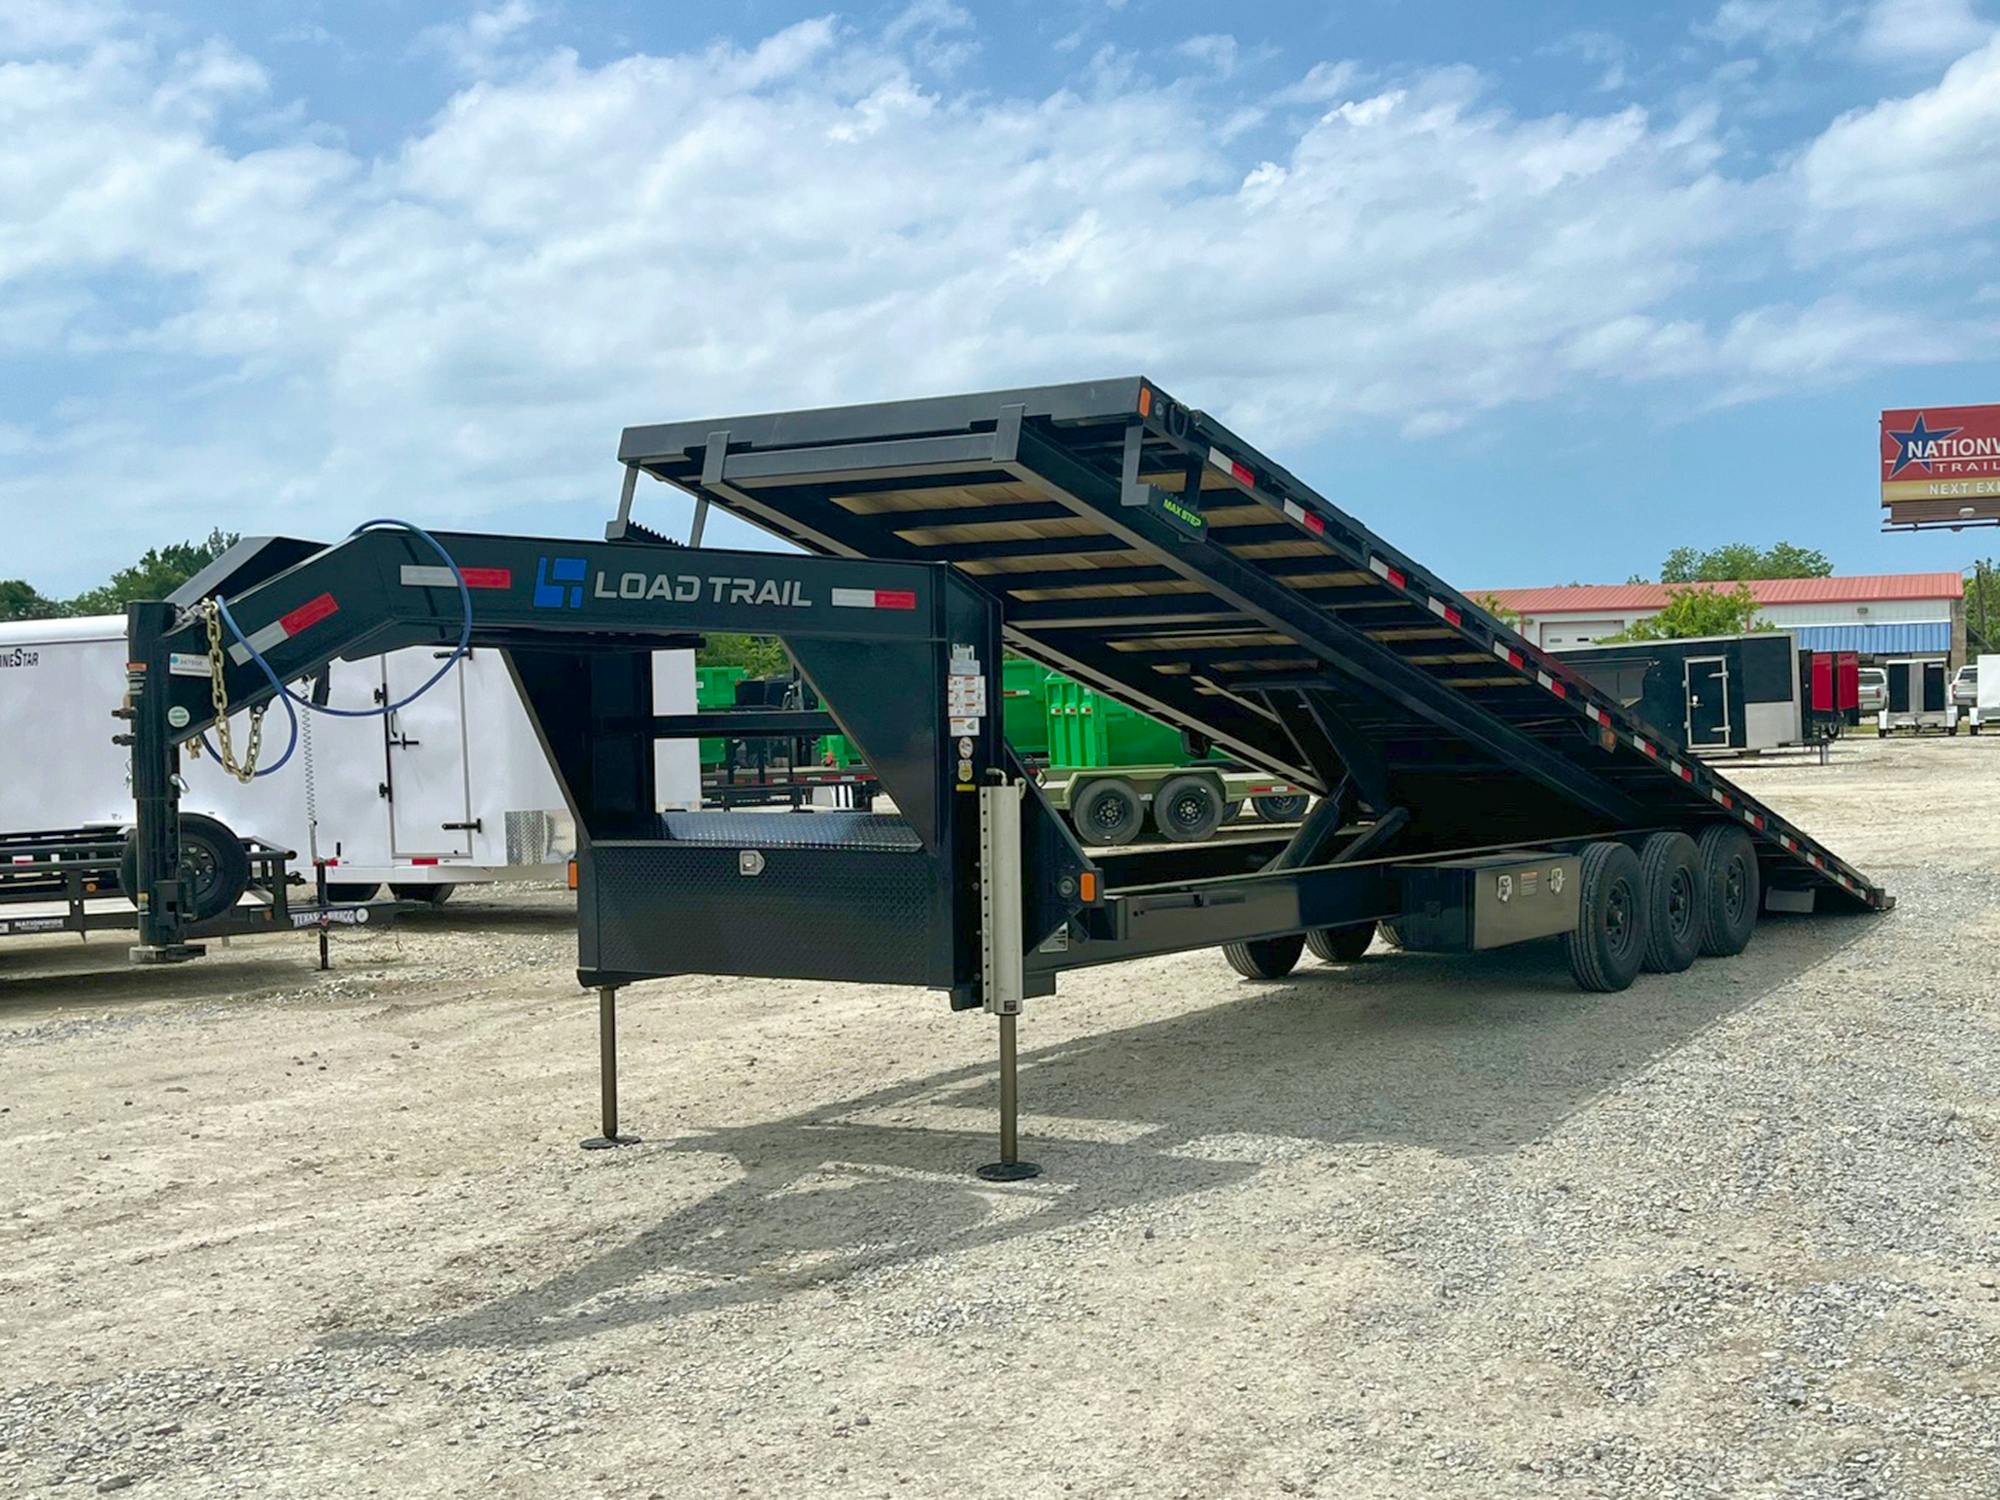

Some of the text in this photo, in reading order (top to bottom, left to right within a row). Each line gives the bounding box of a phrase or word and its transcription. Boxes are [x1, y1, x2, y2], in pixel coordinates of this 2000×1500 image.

[1929, 483, 1969, 495] NEXT
[1163, 499, 1202, 527] MAX STEP
[594, 571, 812, 607] LOAD TRAIL
